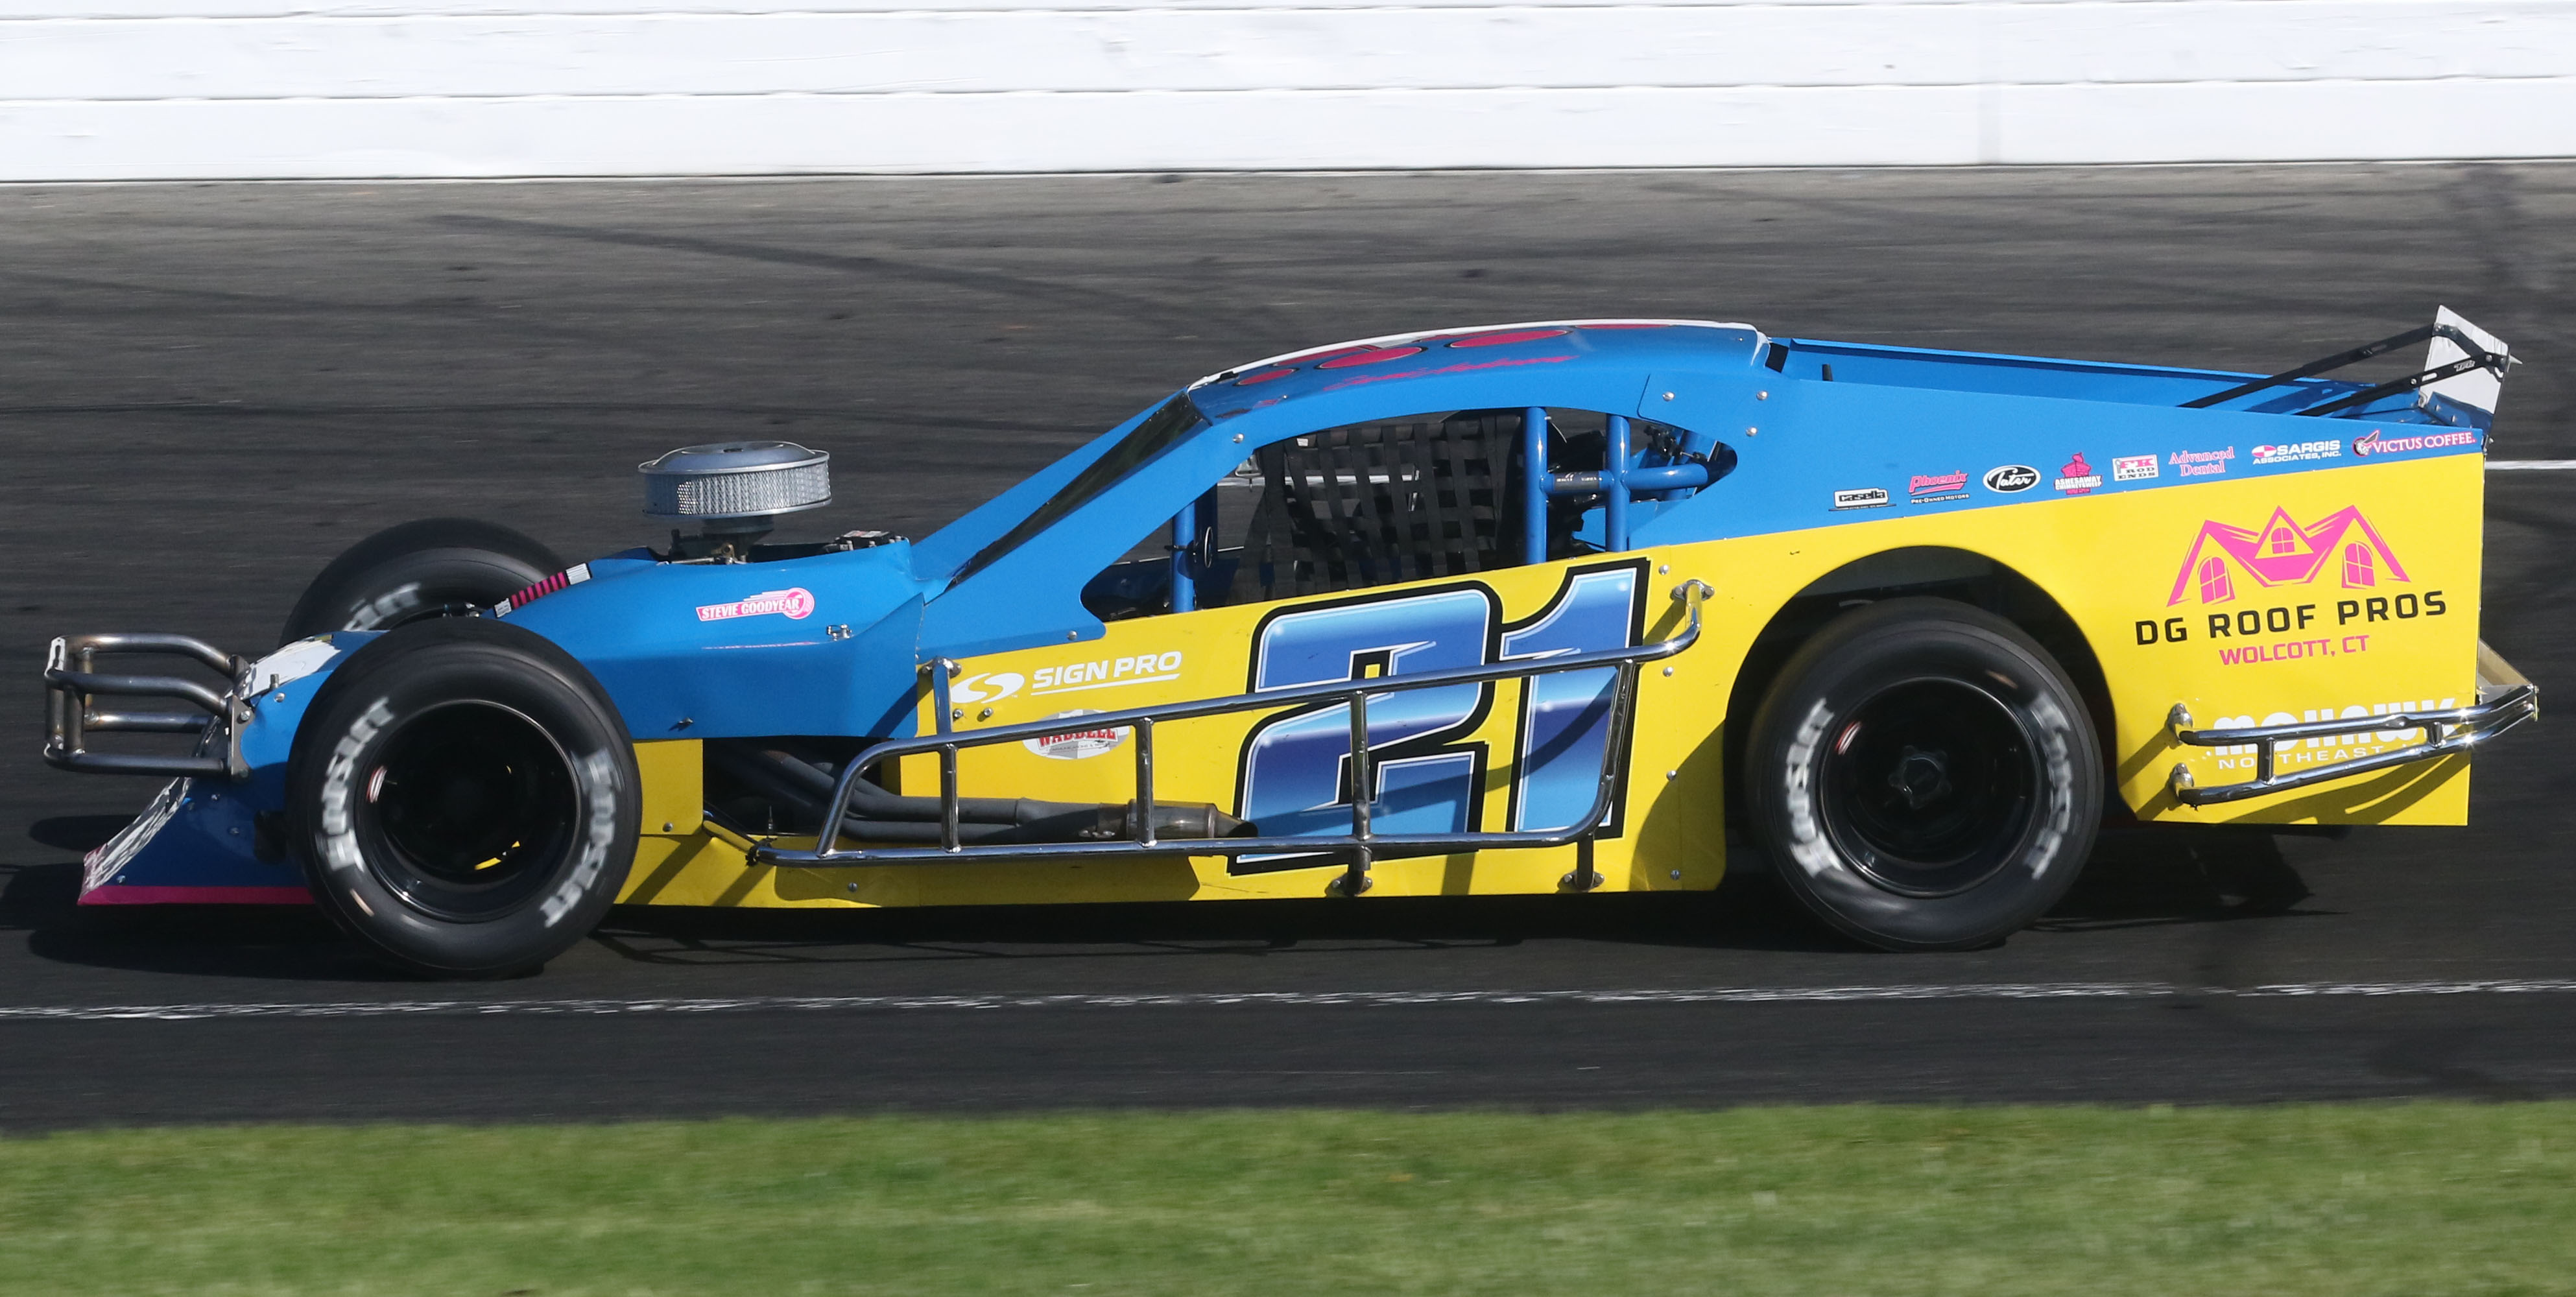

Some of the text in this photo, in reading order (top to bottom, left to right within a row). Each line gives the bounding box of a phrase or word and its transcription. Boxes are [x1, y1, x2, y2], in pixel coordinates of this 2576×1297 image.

[2276, 440, 2341, 455] SARGIS
[2372, 432, 2476, 453] VICTUS COFFEE.
[2168, 446, 2235, 465] Advanced
[2252, 453, 2320, 465] ASSOCIATES,
[1988, 468, 2034, 490] Tater
[2180, 460, 2226, 477] Dental
[1909, 470, 1968, 493] Phoenix
[1839, 490, 1885, 502] casella
[702, 598, 799, 619] STEVIE GOODYEAR
[2135, 590, 2447, 646] DG ROOF PROS
[2219, 635, 2370, 665] WOLCOTT, CT
[1032, 650, 1182, 689] SIGN PRO
[1226, 557, 1651, 877] 21
[2218, 745, 2385, 770] NOTHEAST
